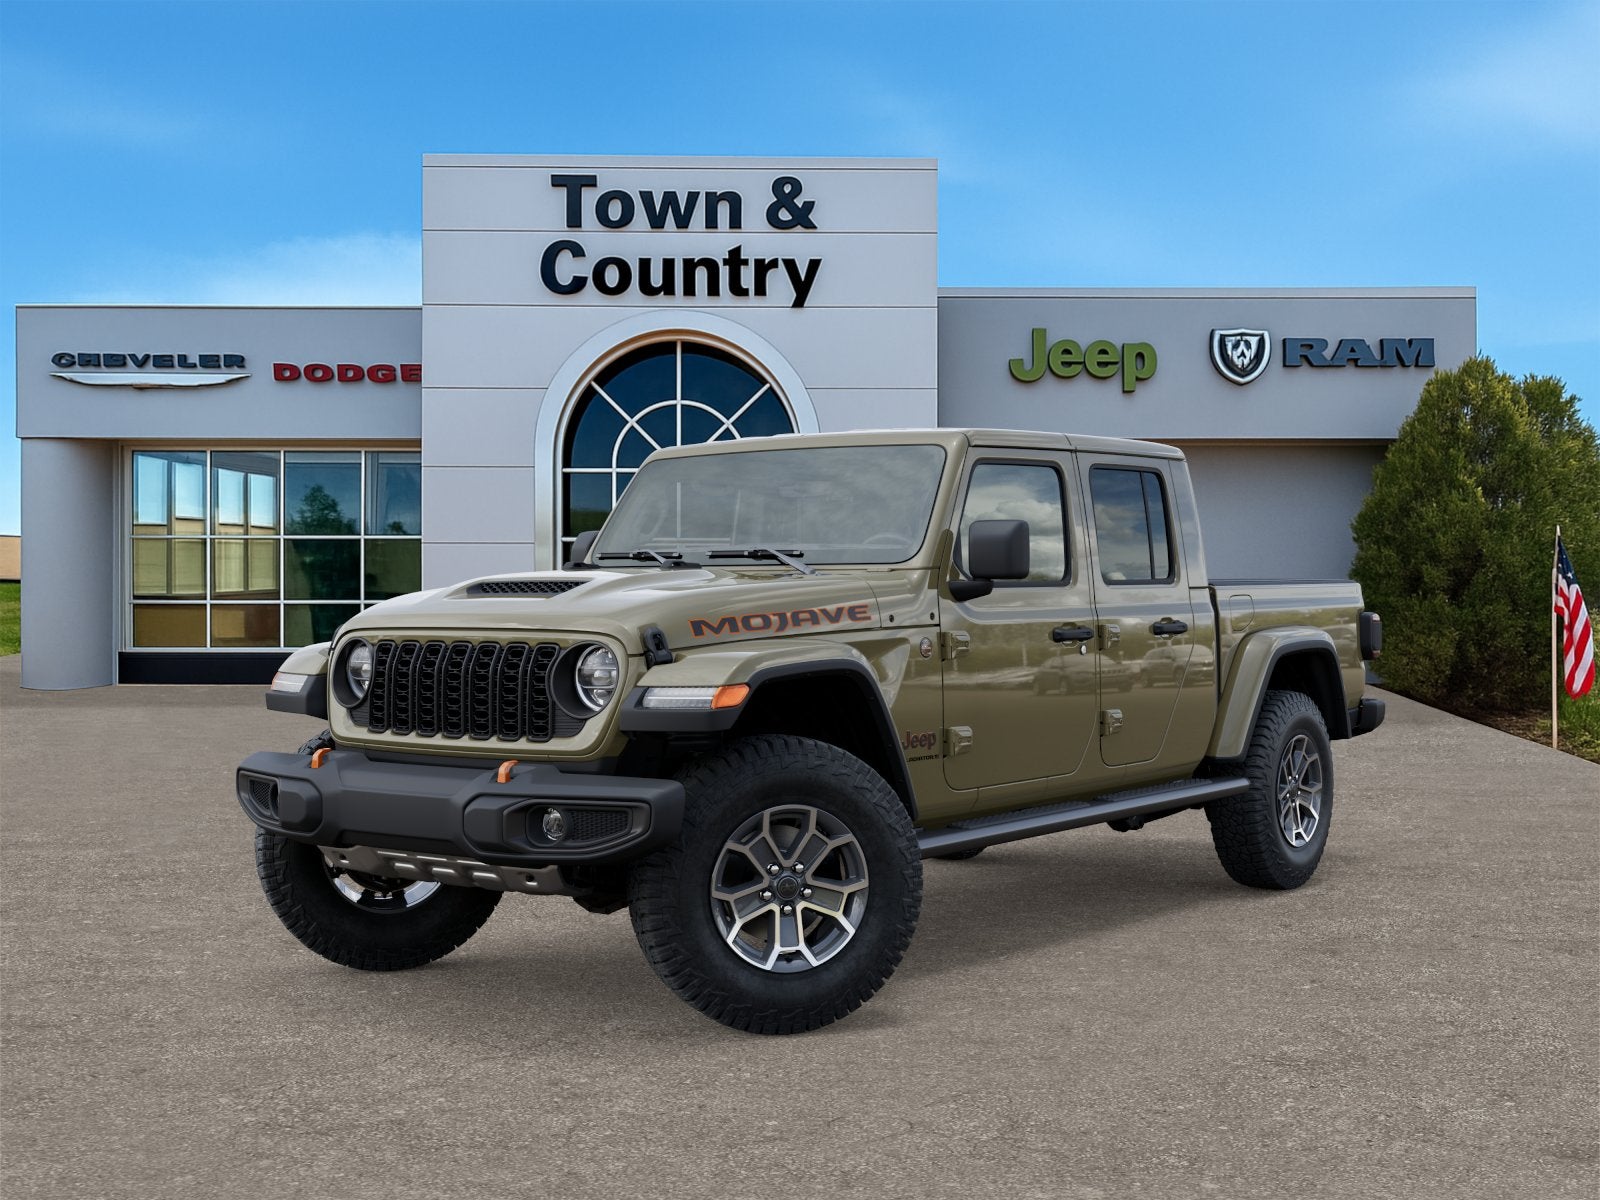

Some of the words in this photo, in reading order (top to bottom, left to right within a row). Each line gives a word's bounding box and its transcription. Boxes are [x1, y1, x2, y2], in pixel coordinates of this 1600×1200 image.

[550, 174, 743, 229] Town
[765, 175, 818, 230] &
[540, 239, 823, 308] Country
[1009, 328, 1158, 393] Jeep
[1282, 337, 1436, 368] RAM
[272, 362, 422, 383] DODGE
[688, 604, 872, 639] MOJAVE
[901, 730, 937, 750] Jeep
